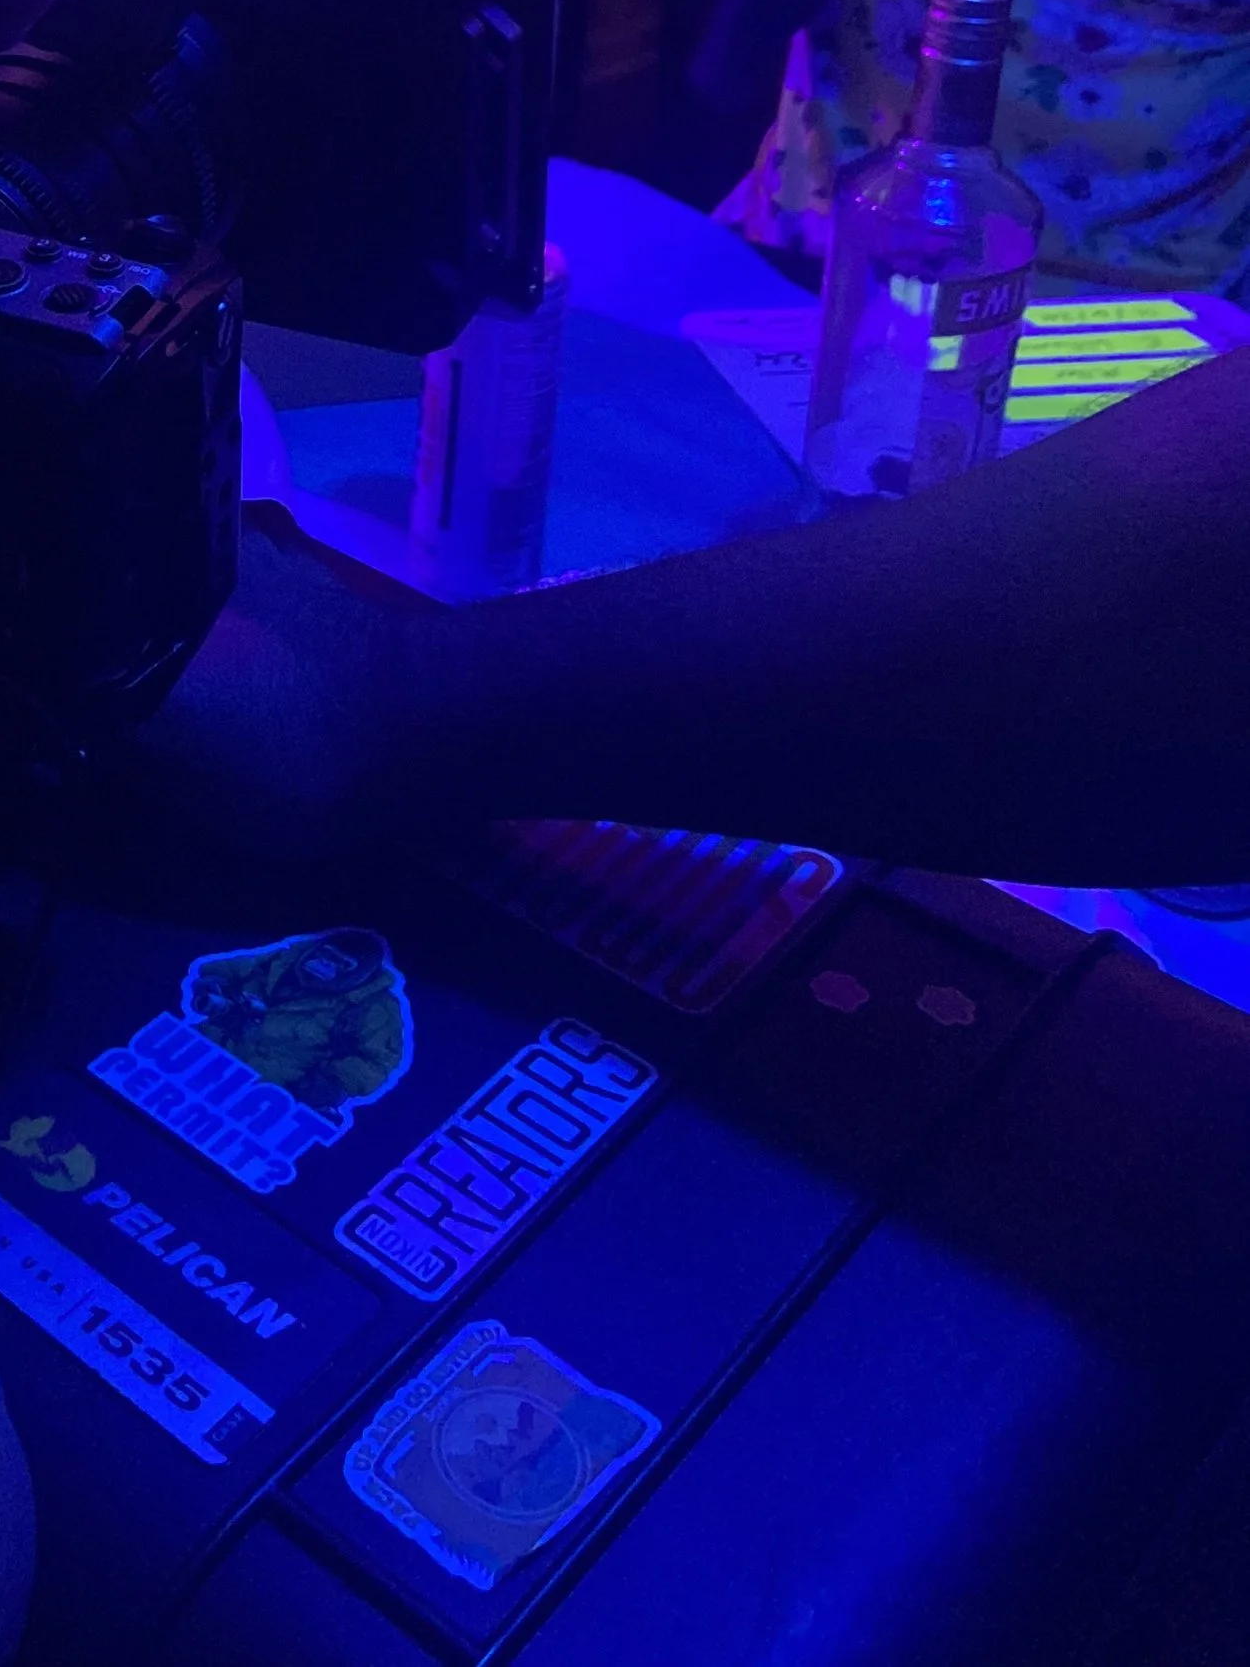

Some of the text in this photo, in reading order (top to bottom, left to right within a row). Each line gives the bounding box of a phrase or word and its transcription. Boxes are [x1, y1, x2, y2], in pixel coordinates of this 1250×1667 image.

[956, 279, 1021, 321] SMI
[95, 1048, 295, 1192] PERMIT?
[132, 1014, 336, 1152] WHAT
[340, 1018, 653, 1299] CREATORS
[81, 1183, 298, 1340] PELICAN
[362, 1217, 442, 1279] NIKON
[79, 1302, 211, 1417] 1535
